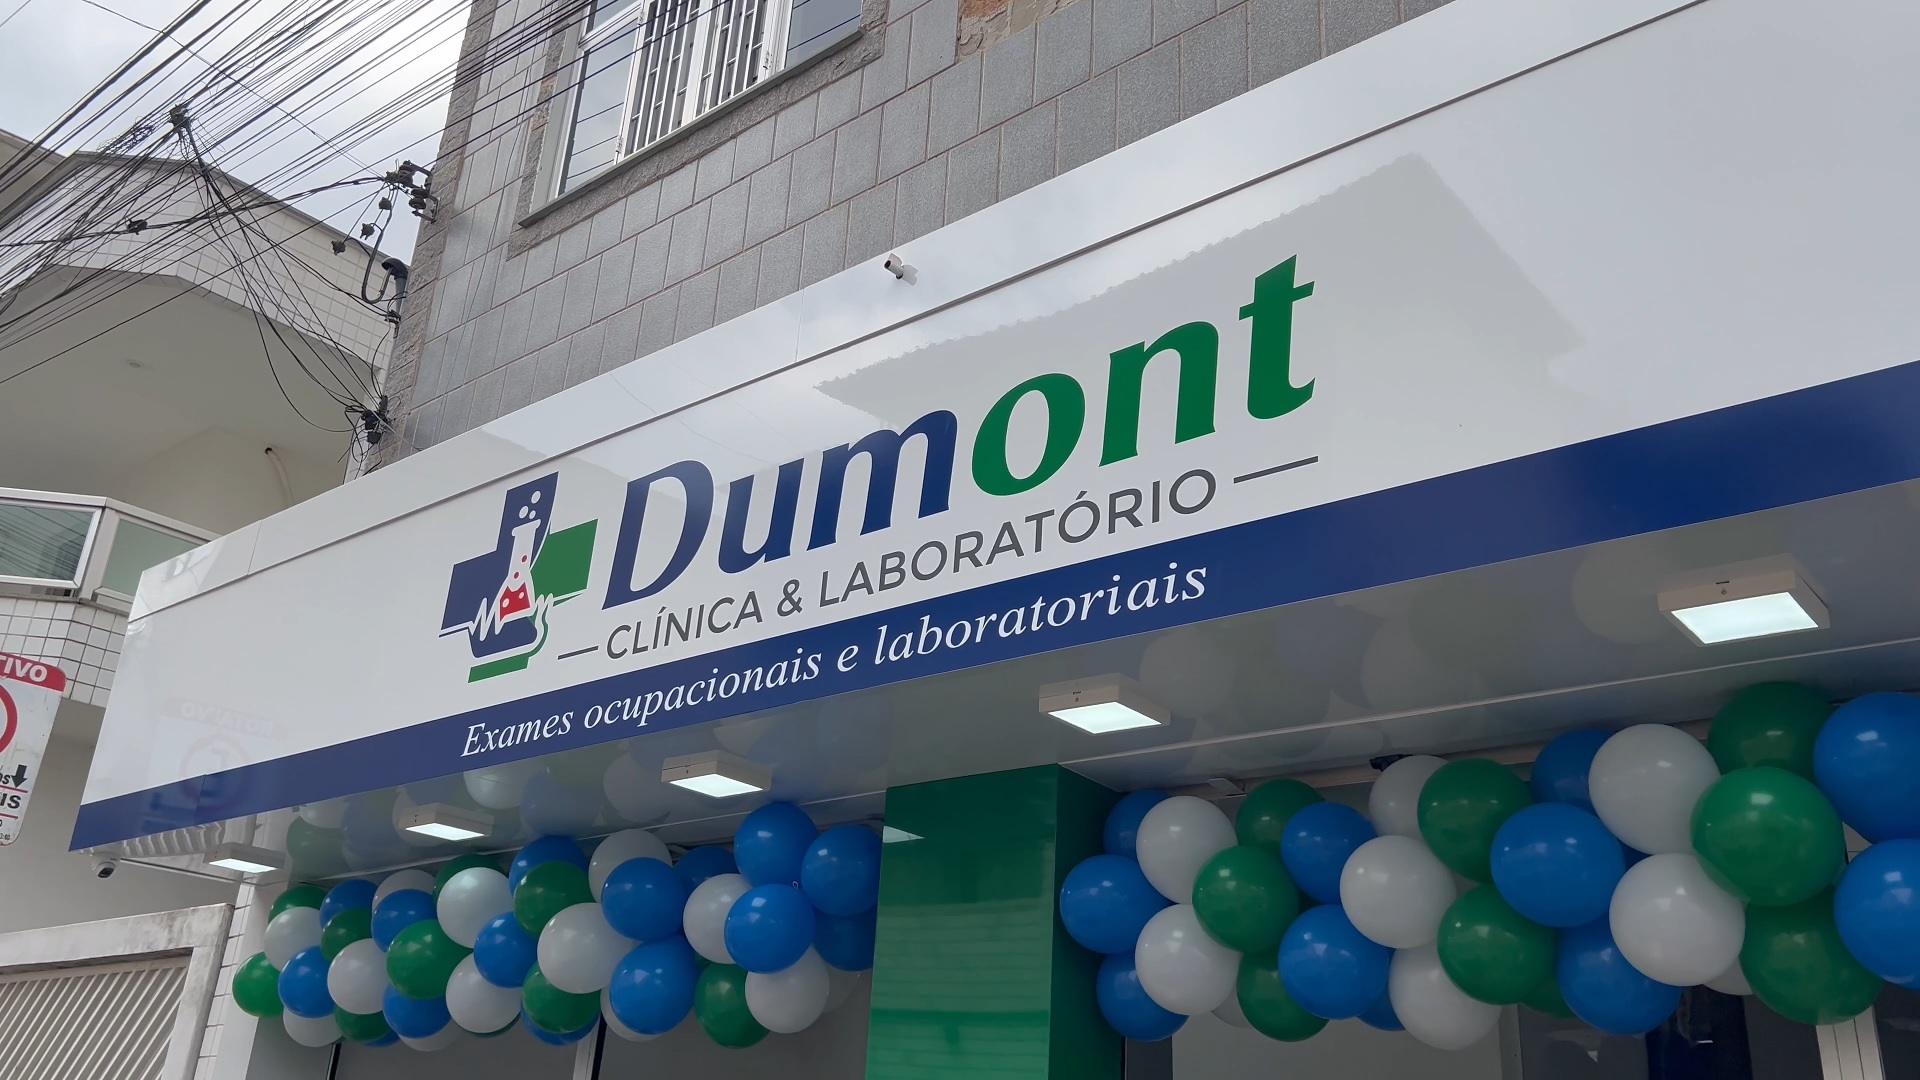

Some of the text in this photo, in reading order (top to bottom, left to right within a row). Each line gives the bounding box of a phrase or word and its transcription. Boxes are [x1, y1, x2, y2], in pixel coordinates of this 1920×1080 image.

[602, 254, 1316, 611] Dumont
[461, 562, 1207, 758] Exames ocupacionais e laboratoriais
[606, 468, 1217, 660] CLÍNICA & LABORATÓRIO
